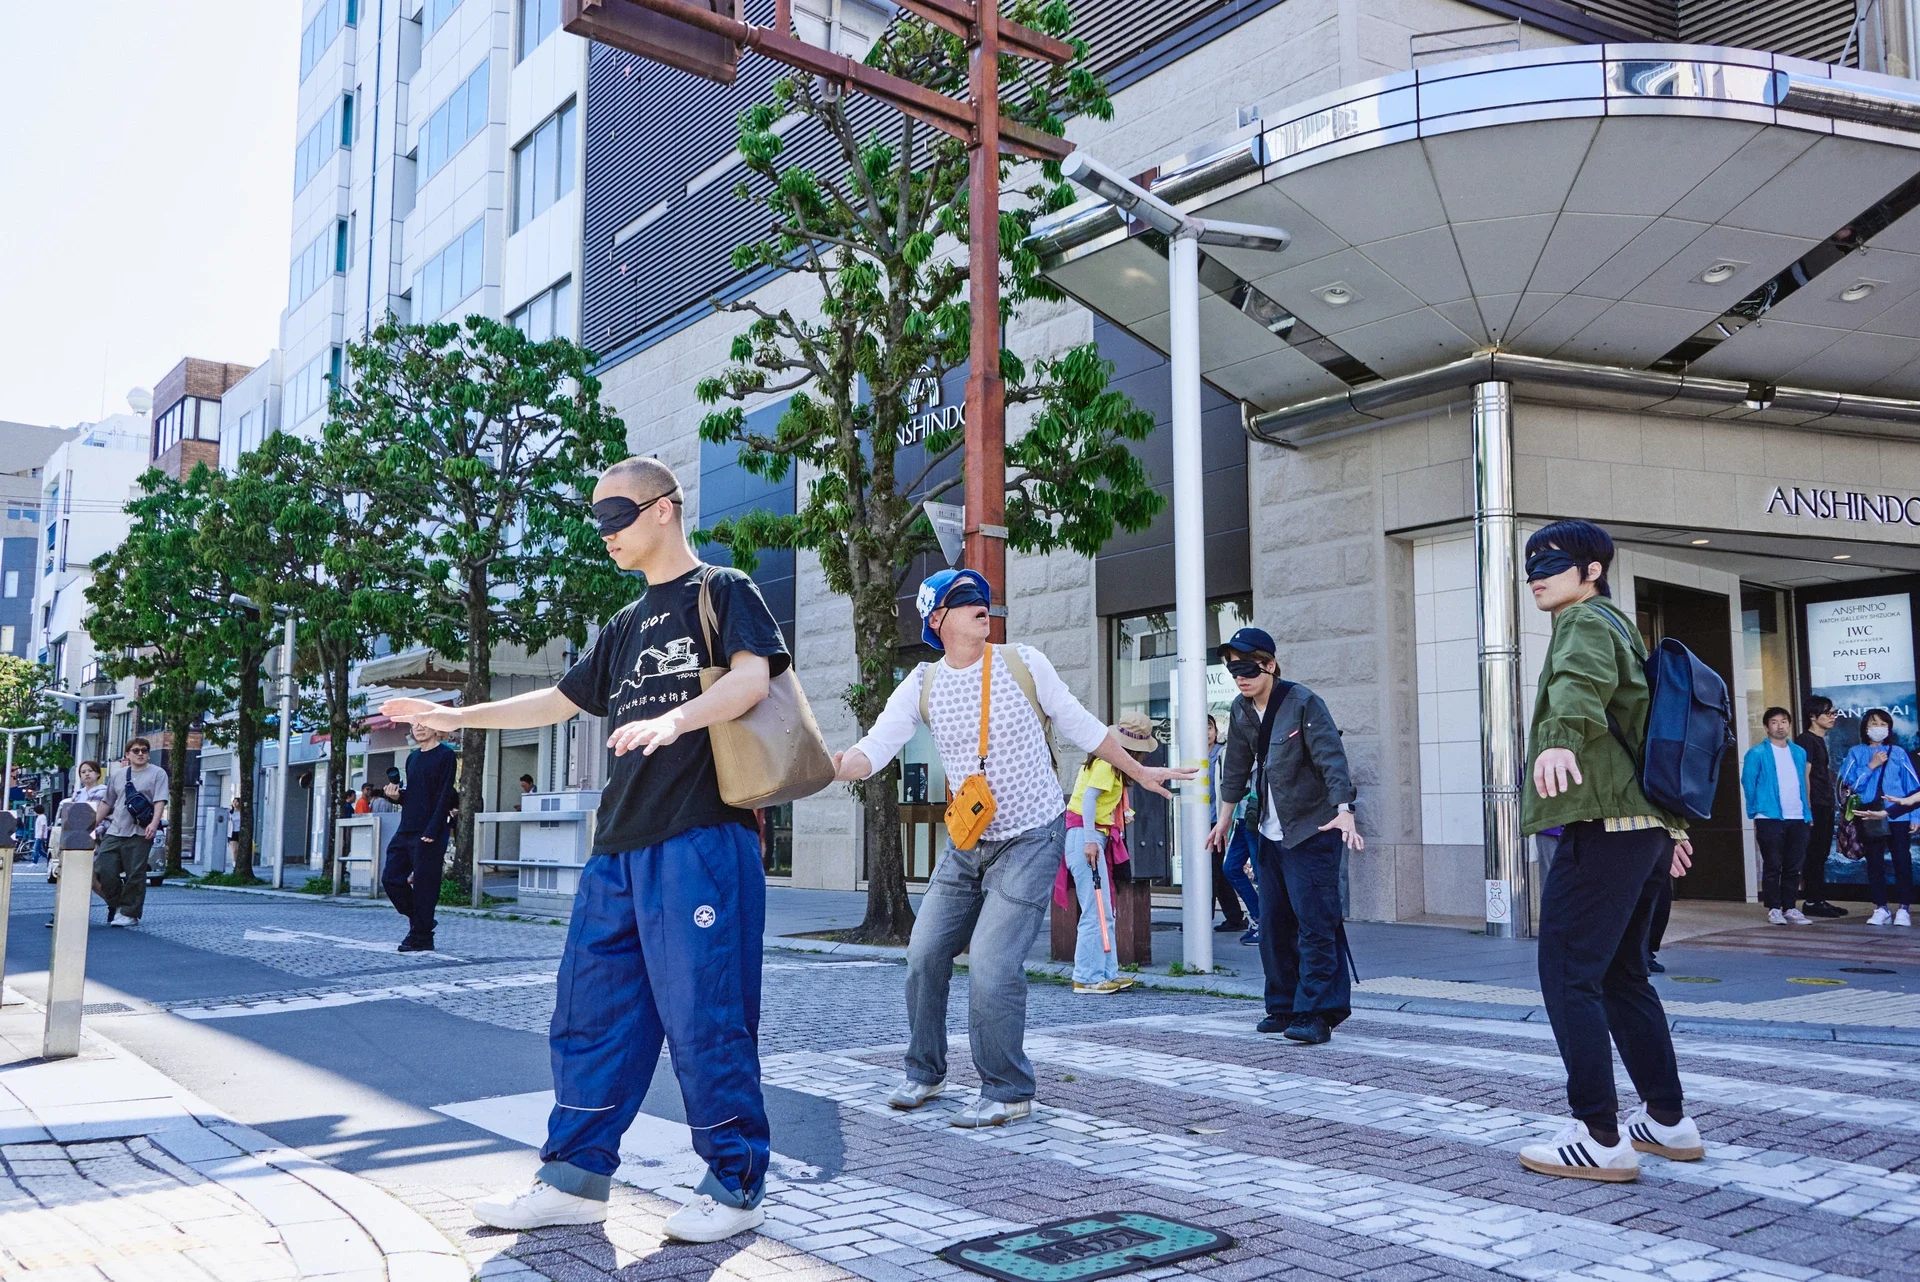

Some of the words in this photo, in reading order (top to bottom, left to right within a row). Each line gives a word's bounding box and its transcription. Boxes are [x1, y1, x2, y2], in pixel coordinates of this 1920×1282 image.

[896, 401, 966, 446] NSHIND
[1766, 485, 1920, 527] ANSHINDO
[1832, 602, 1886, 616] ANSHINDO
[1869, 611, 1901, 619] SHIZUOKA
[640, 612, 670, 633] SLOT
[1847, 625, 1873, 637] IWC
[1833, 646, 1890, 657] PANERAI
[1206, 672, 1226, 685] WC
[1845, 672, 1881, 682] TUDOR
[1834, 704, 1909, 719] ANAI
